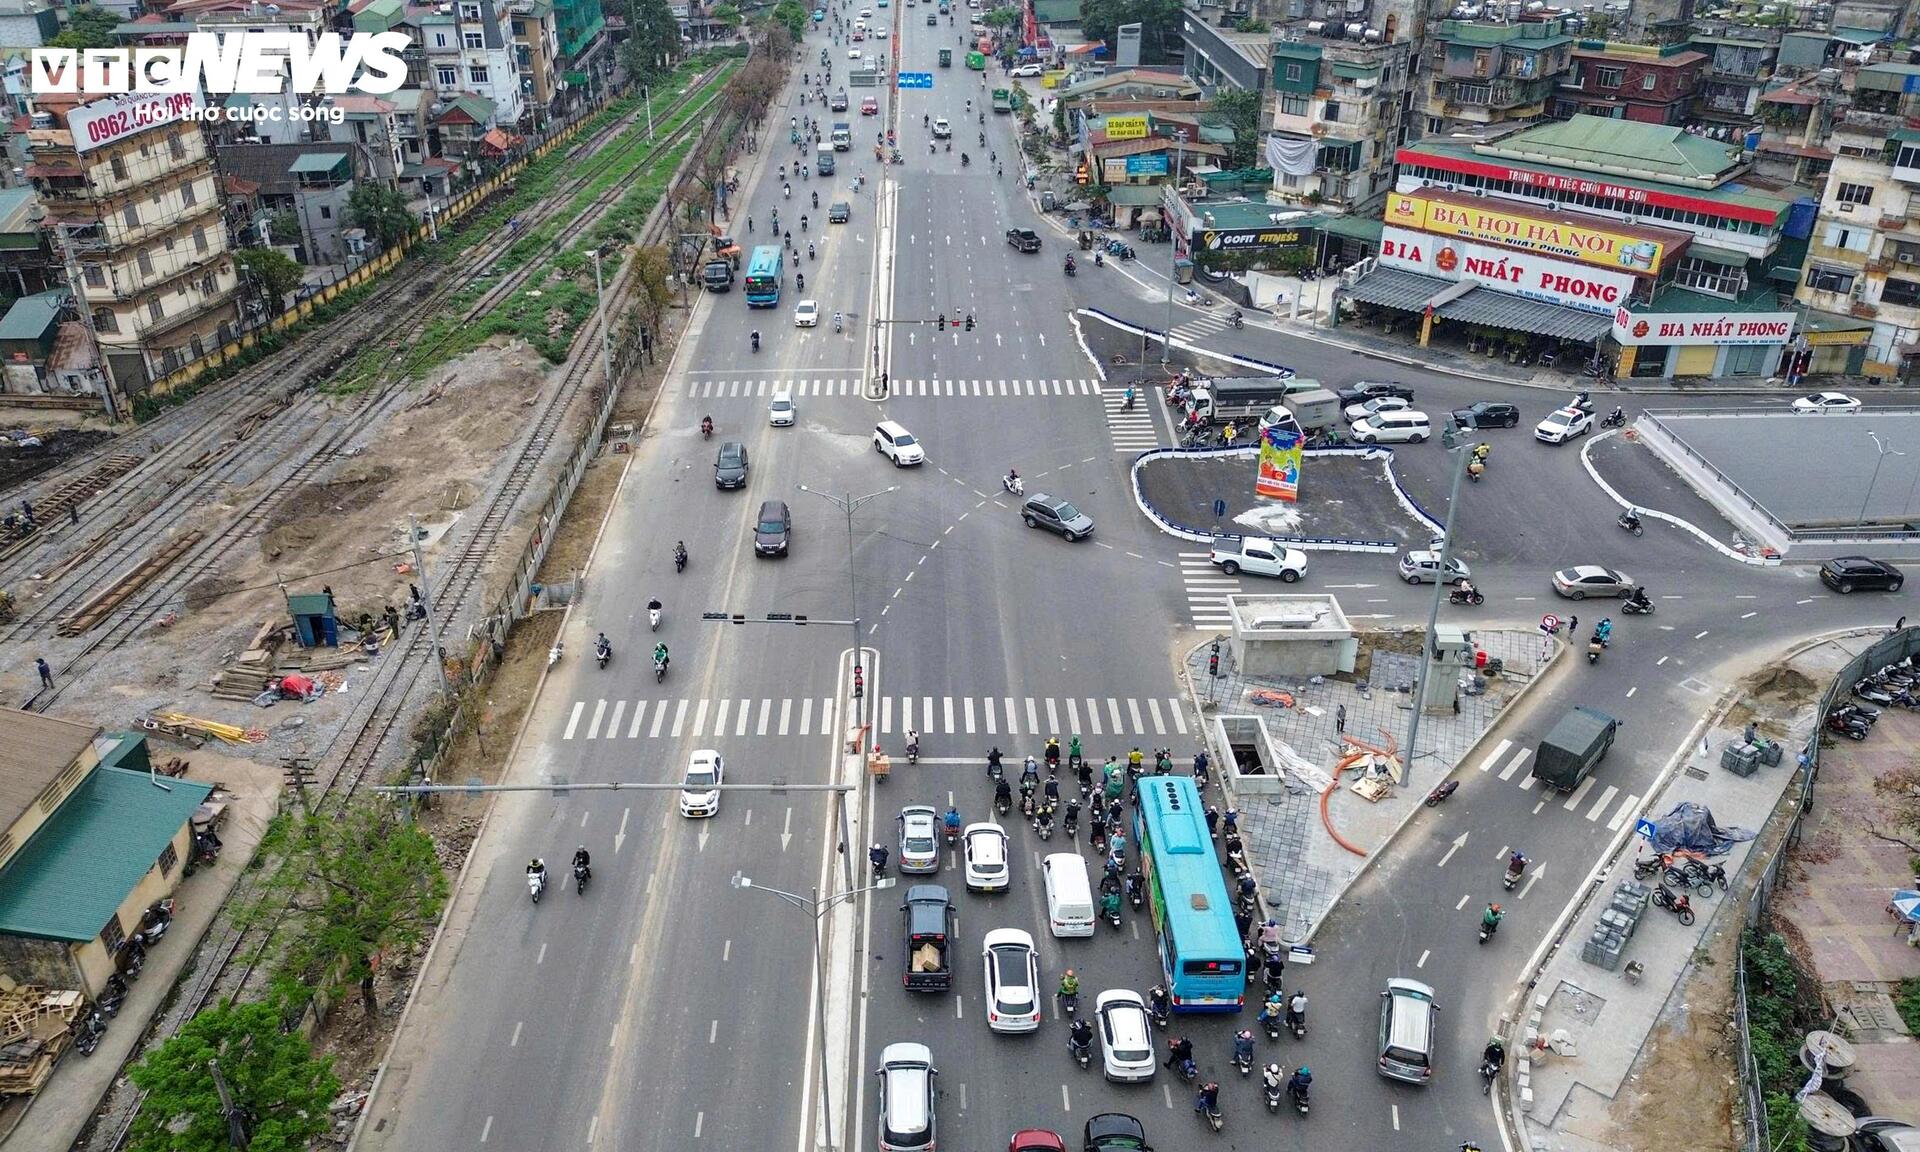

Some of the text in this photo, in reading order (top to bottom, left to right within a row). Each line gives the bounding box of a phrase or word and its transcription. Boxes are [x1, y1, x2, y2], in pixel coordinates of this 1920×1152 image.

[1604, 186, 1625, 198] NAM
[1223, 231, 1299, 244] GOFIT FITNESS
[1433, 207, 1469, 227] BIA
[1527, 225, 1560, 243] HÀ
[1567, 232, 1615, 254] NỘI
[1382, 240, 1618, 303] BIA NHẤT PHONG
[1659, 316, 1788, 336] BIA NHẤT PHONG
